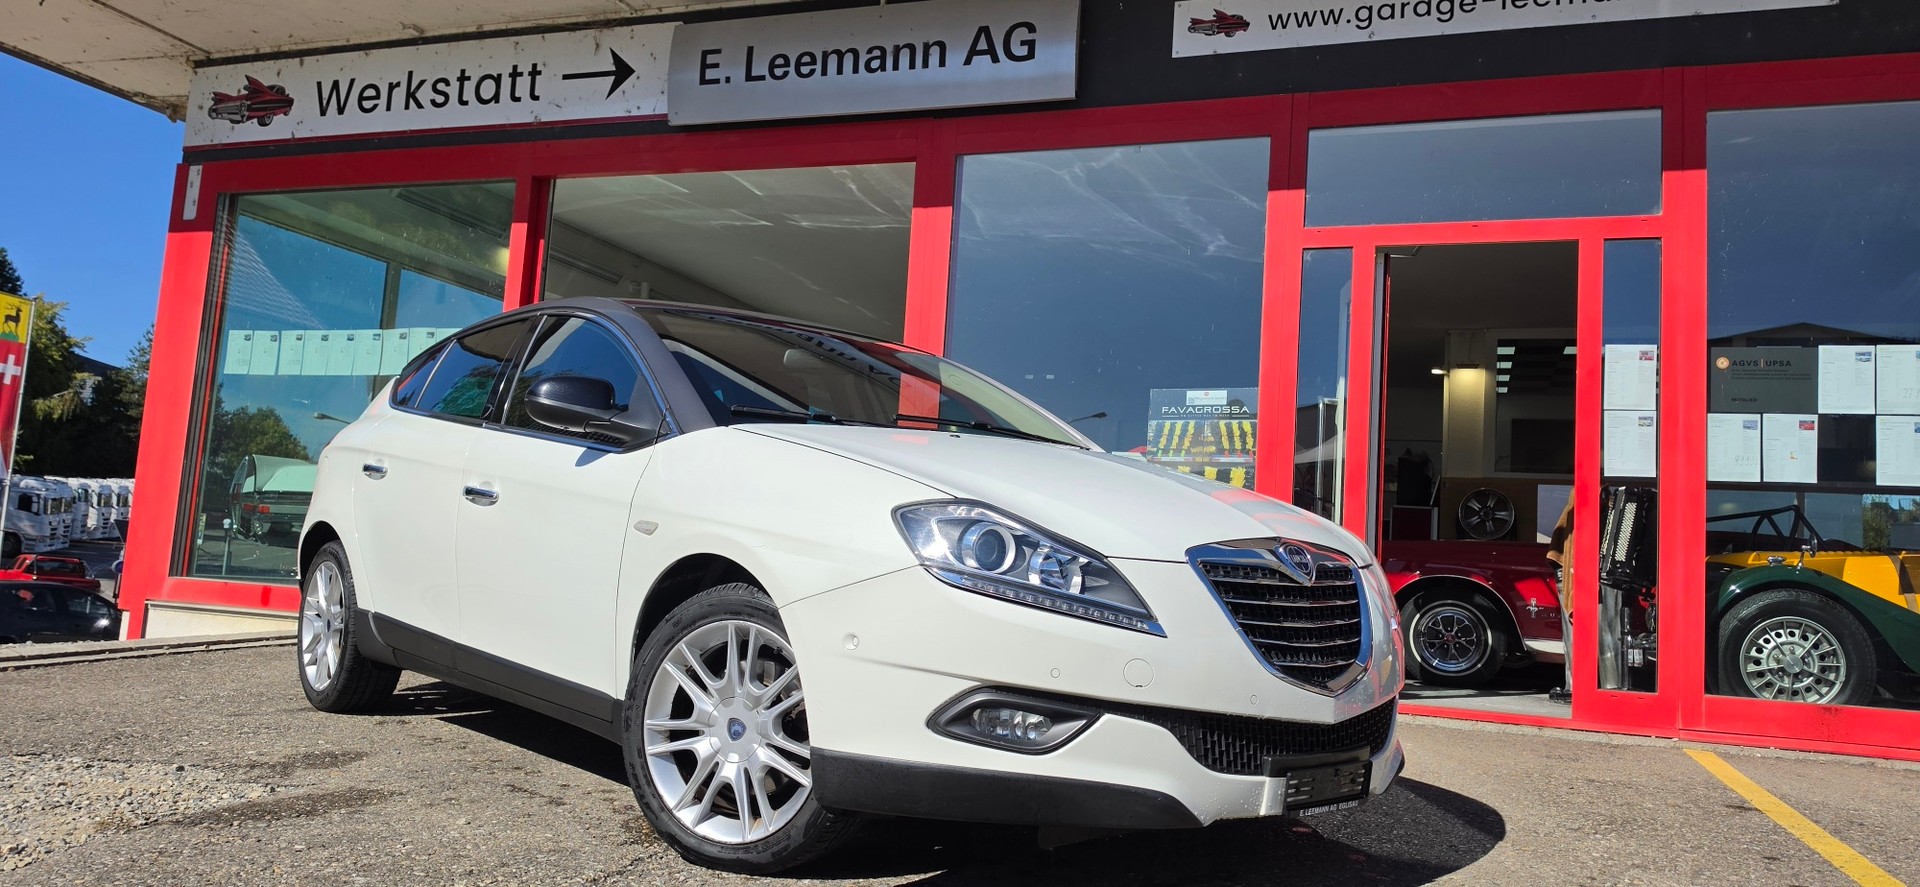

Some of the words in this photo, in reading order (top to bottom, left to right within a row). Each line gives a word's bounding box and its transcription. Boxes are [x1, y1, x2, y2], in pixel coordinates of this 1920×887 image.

[699, 48, 731, 85] E.
[744, 39, 947, 83] Leemann
[962, 21, 1037, 67] AG
[315, 62, 542, 117] Werkstatt
[1161, 406, 1250, 414] FAVAGROSSA
